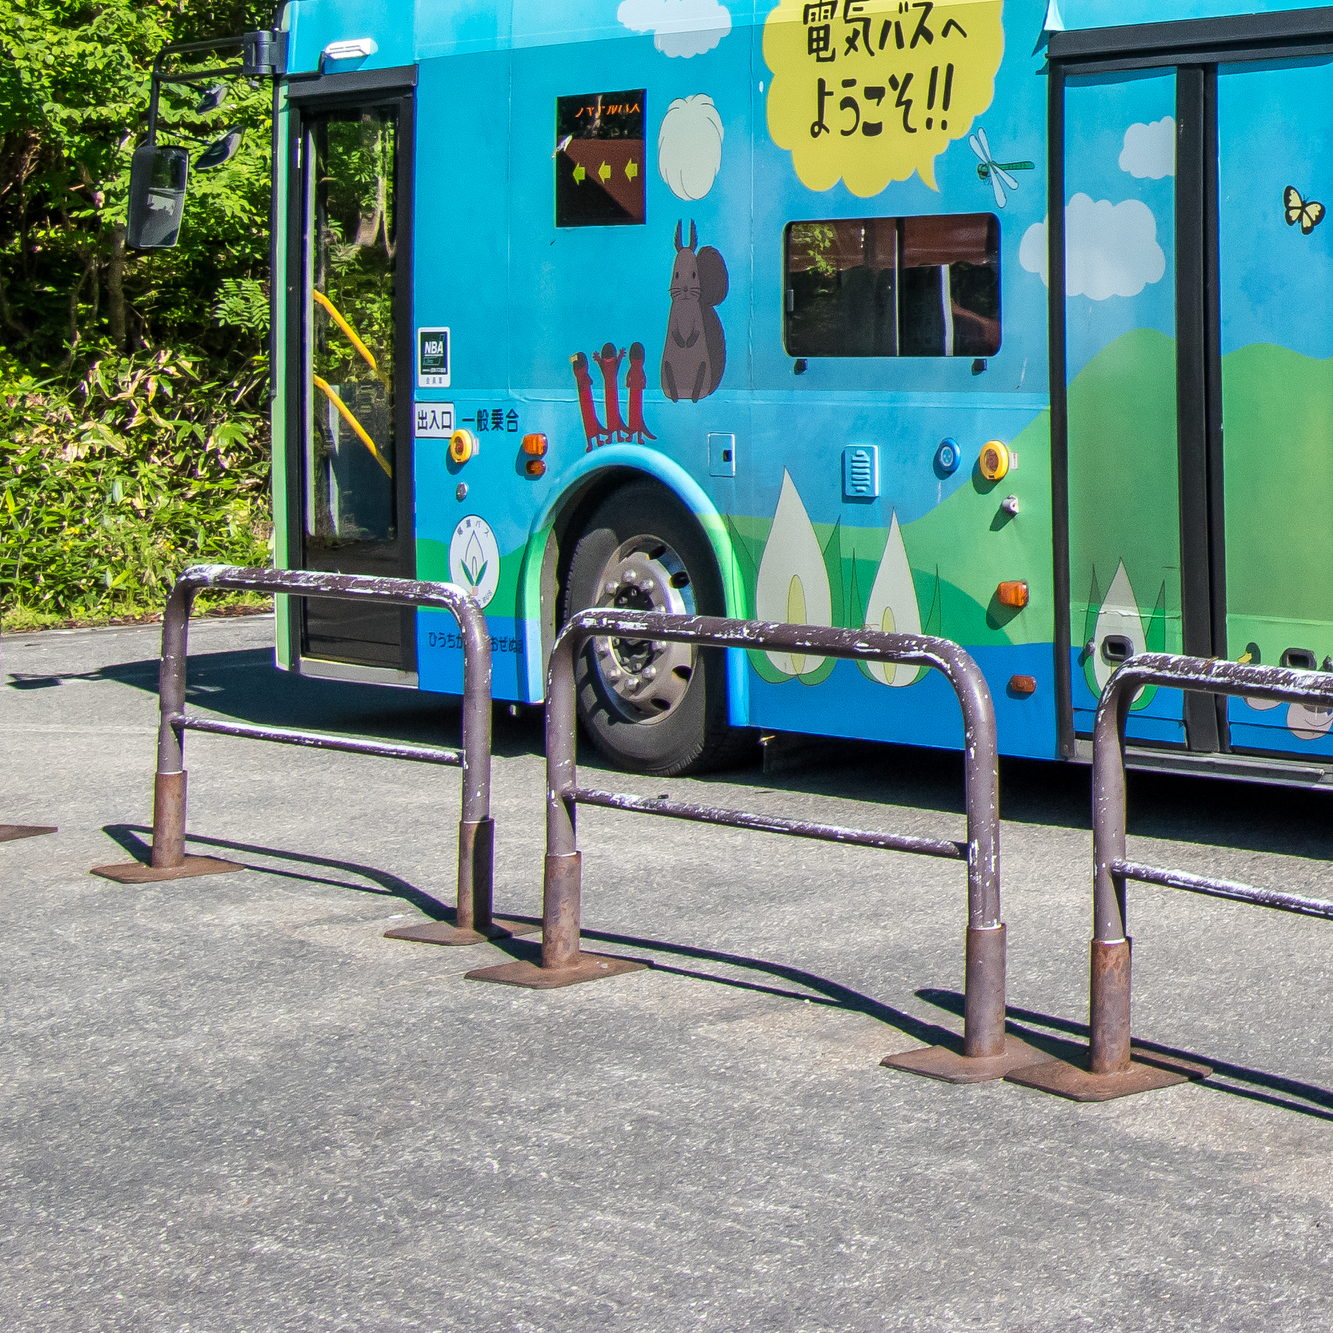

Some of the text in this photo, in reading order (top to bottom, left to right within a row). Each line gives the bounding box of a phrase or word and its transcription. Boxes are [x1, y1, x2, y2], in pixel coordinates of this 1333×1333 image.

[810, 63, 954, 138] ようこそ!!
[424, 340, 444, 355] NBA
[417, 410, 452, 430] 出入口
[462, 408, 519, 432] 一般乗合
